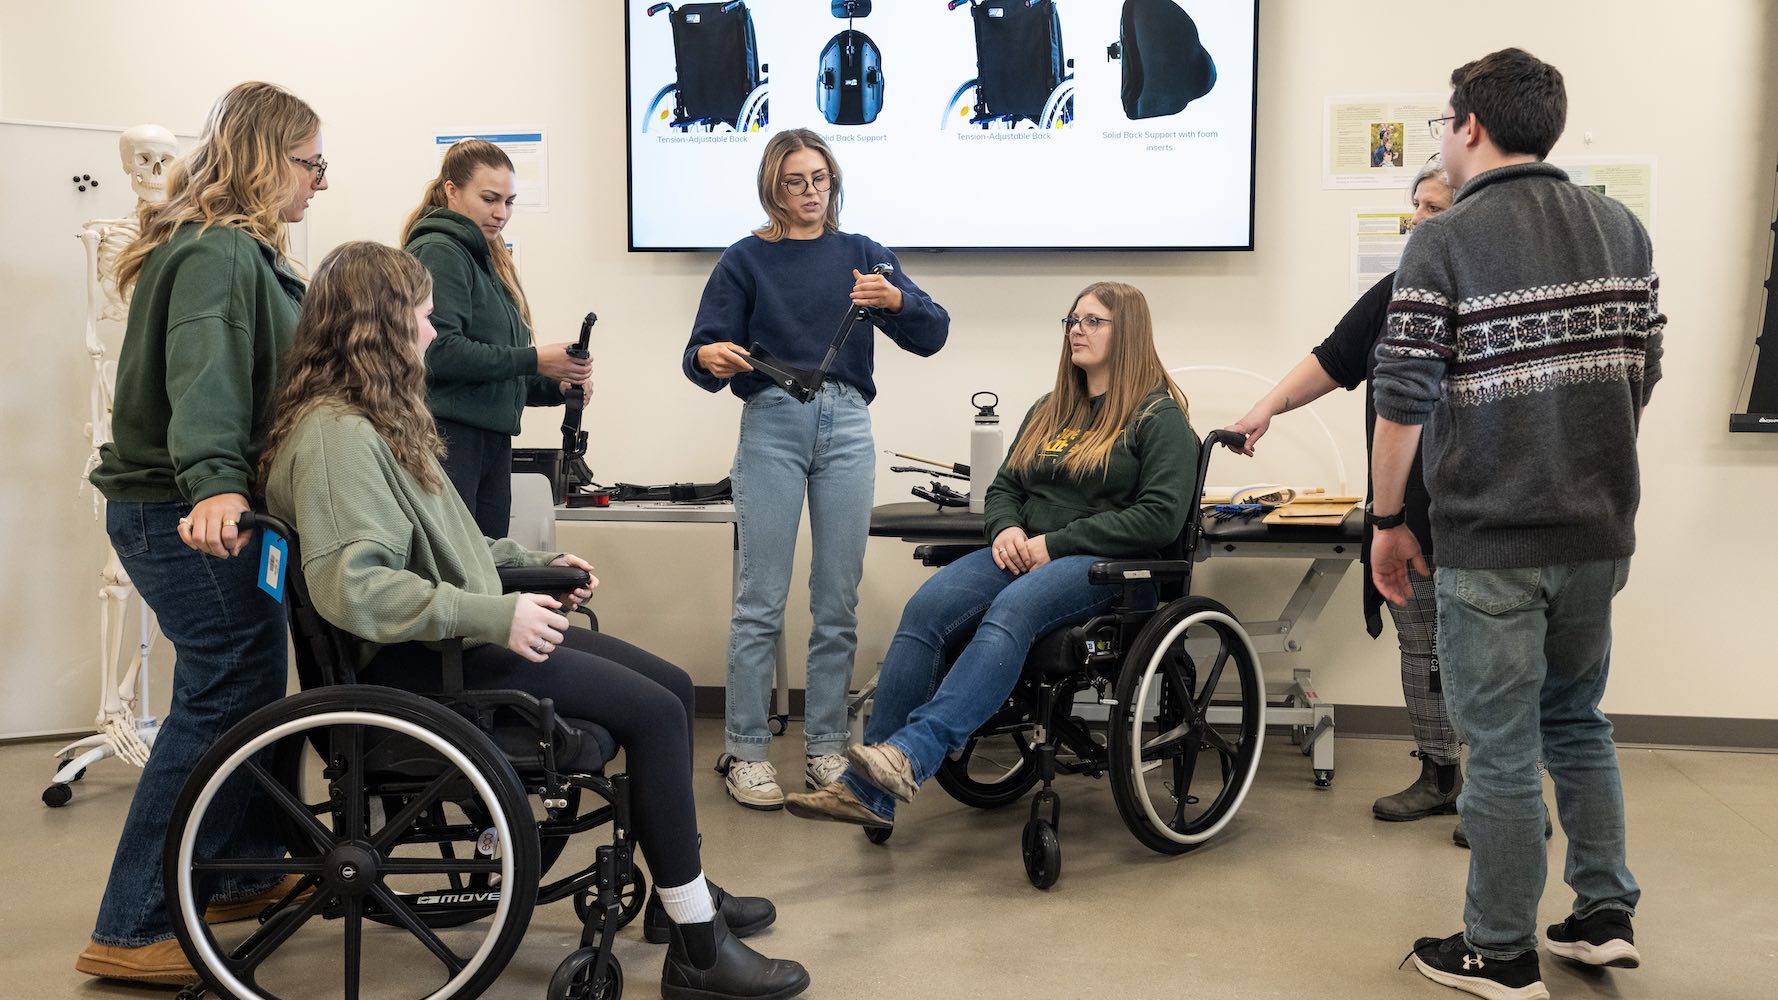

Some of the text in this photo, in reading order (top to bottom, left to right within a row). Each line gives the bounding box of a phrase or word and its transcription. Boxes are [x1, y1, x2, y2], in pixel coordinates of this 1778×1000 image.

[657, 135, 748, 144] Tension-Adjustable Back
[820, 133, 887, 143] olid Back Support
[957, 132, 1051, 141] Tension-Adjustable Back
[1102, 130, 1219, 140] Solid Back Support with foam
[440, 892, 501, 903] MOVE
